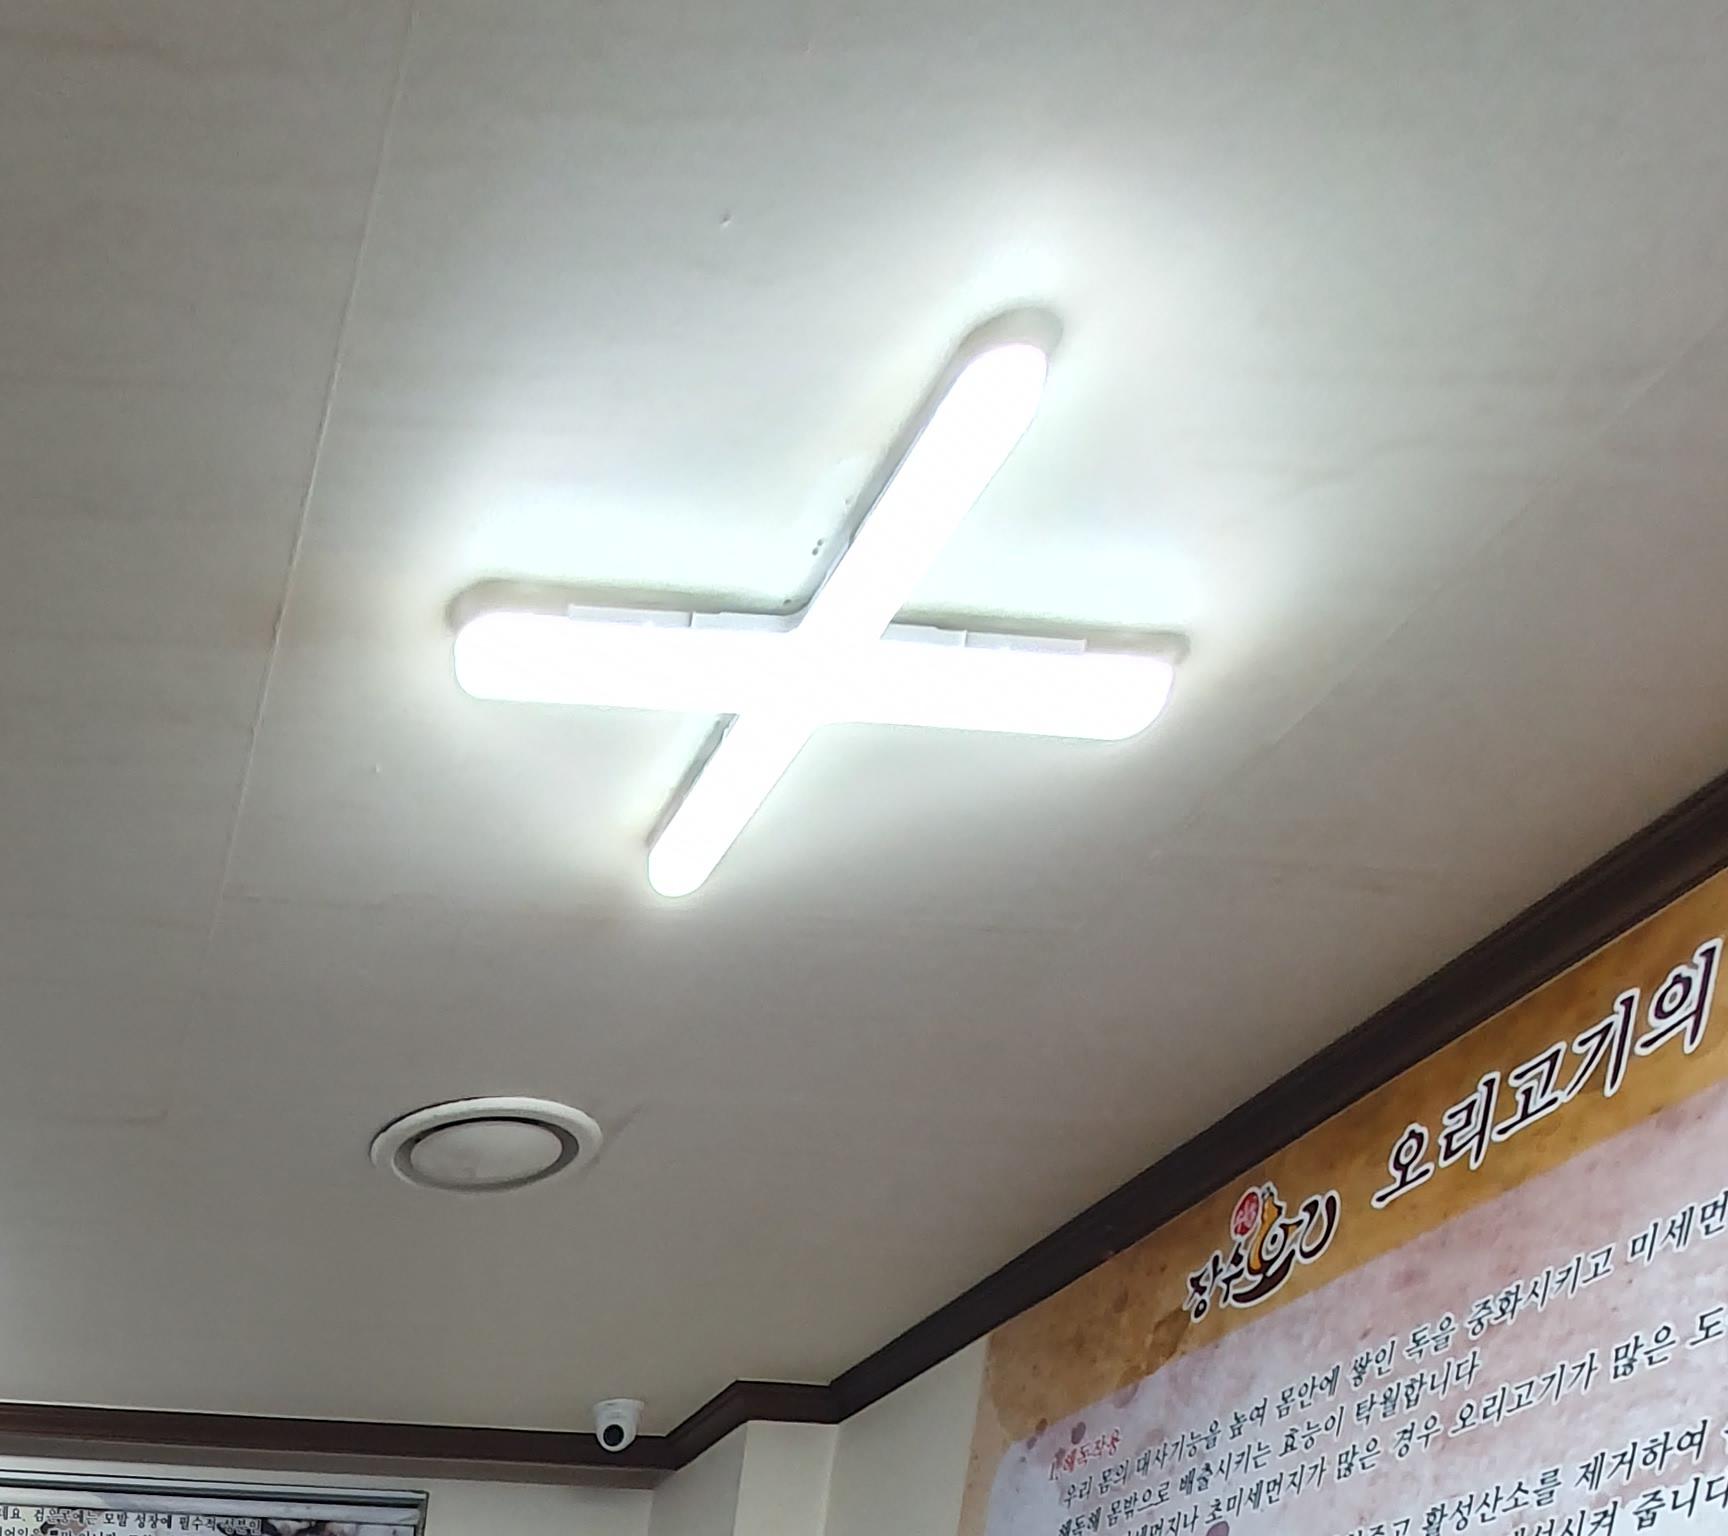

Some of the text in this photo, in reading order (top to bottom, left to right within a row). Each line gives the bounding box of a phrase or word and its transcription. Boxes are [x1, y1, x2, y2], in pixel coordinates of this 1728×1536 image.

[1373, 942, 1719, 1207] 오리고기의
[1064, 1476, 1092, 1508] 우리
[1098, 1460, 1128, 1494] 몸의
[1137, 1420, 1221, 1474] 대사기능을
[1276, 1366, 1340, 1419] 몸안에
[1352, 1340, 1395, 1387] 쌓인
[1406, 1317, 1455, 1358] 독을
[1468, 1248, 1612, 1342] 중화시키고
[1108, 1482, 1170, 1526] 몸밖으로
[1180, 1442, 1271, 1495] 배출시키는
[1278, 1406, 1344, 1456] 효능이
[1356, 1351, 1478, 1424] 탁월합니다
[1205, 1456, 1326, 1524] 초미세먼지가
[1337, 1438, 1380, 1480] 많은
[1394, 1416, 1440, 1458] 경우
[1446, 1352, 1598, 1440] 오리고기가
[1613, 1326, 1676, 1379] 많은
[1575, 1420, 1708, 1490] 제거하여
